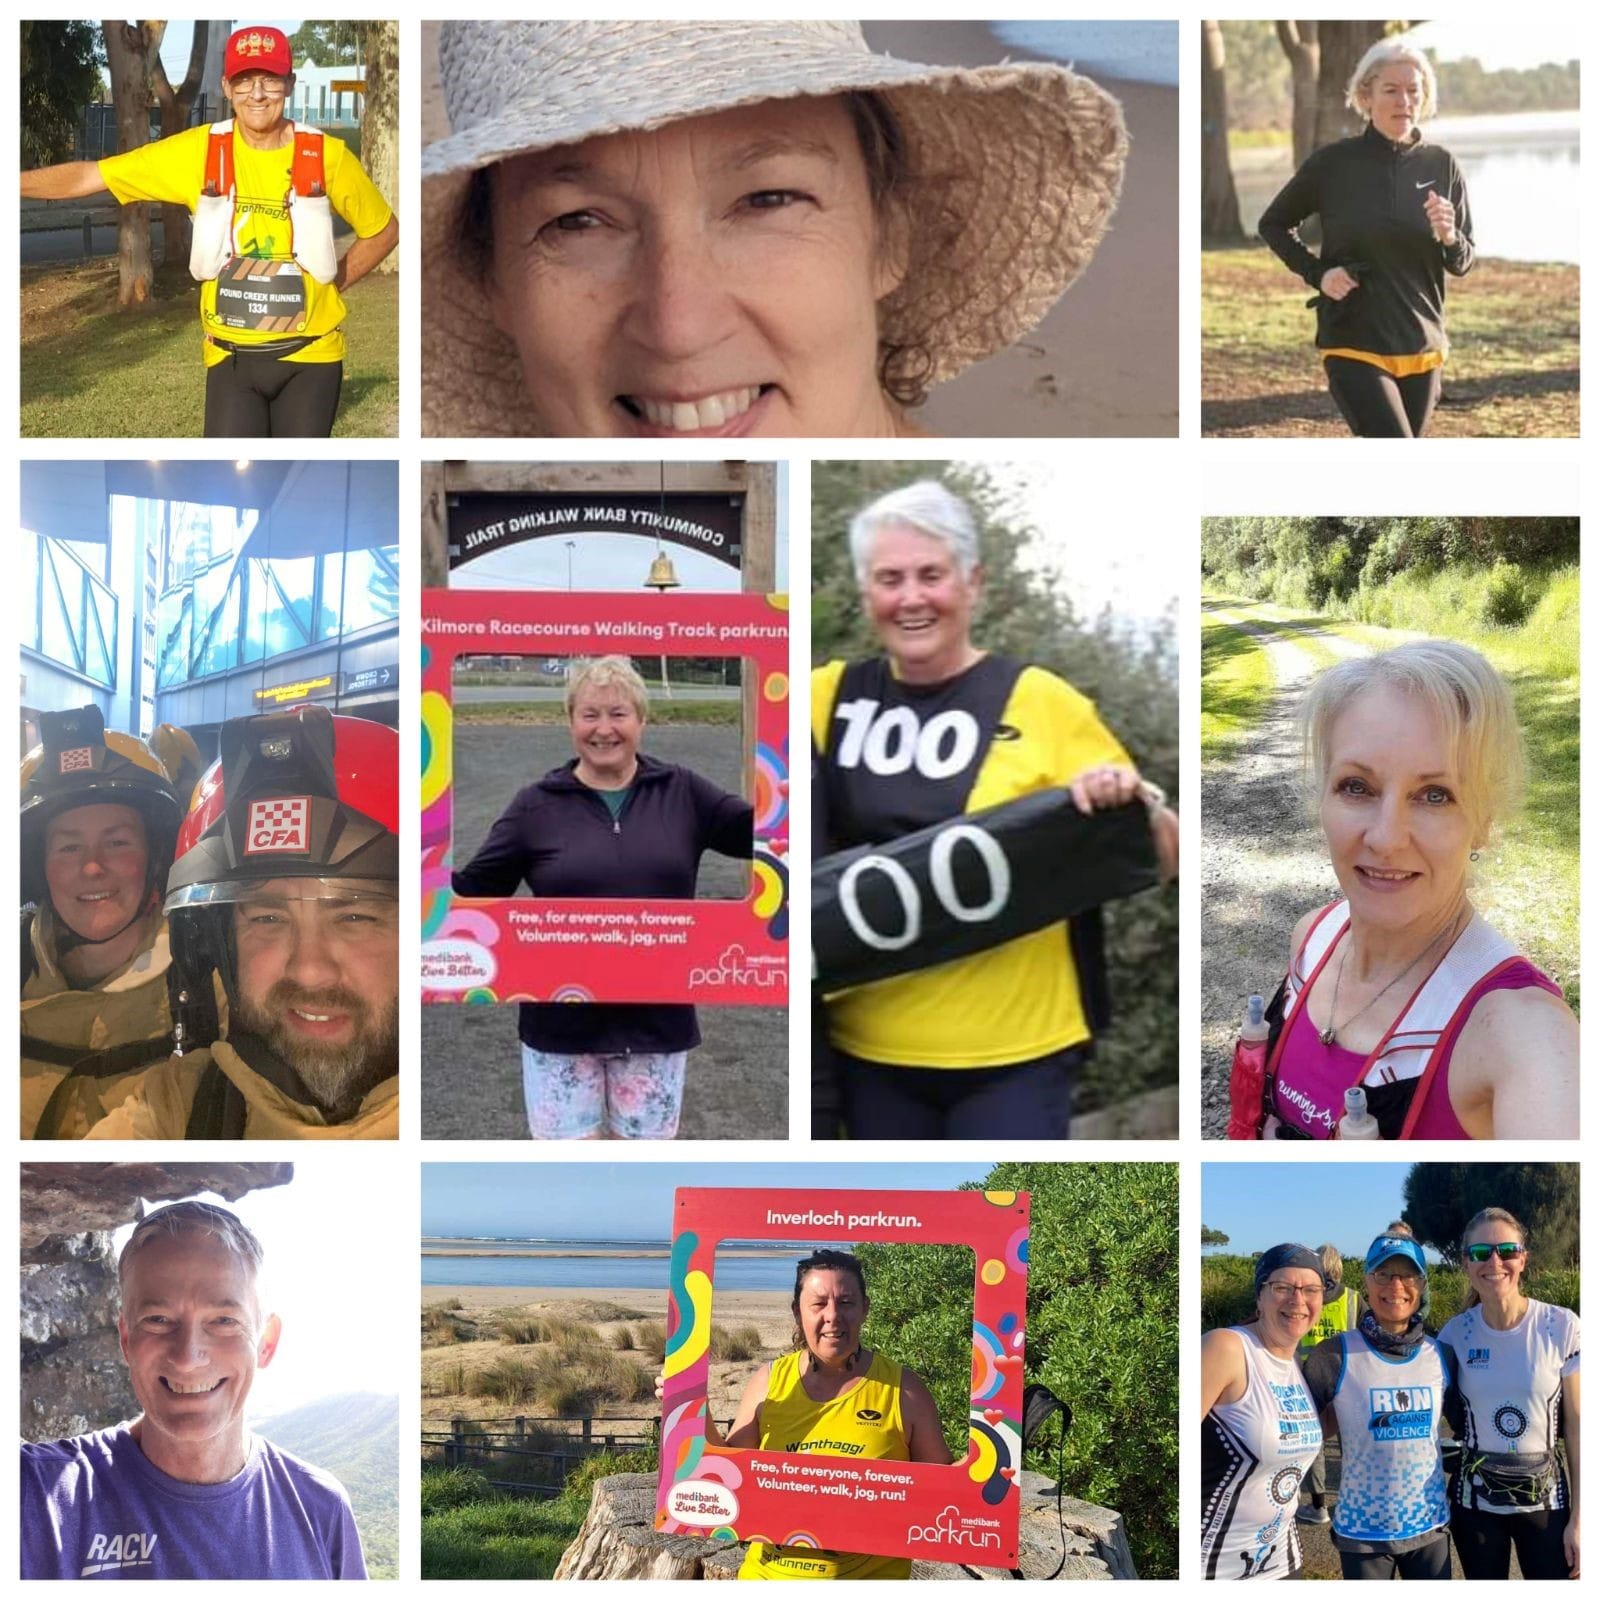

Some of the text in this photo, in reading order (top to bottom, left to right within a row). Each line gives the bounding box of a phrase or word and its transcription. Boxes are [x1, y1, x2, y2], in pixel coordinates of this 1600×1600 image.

[219, 288, 302, 303] POUND CREEK RUNNER
[248, 303, 268, 314] 1334
[421, 619, 486, 635] Kilmore
[490, 620, 591, 636] Racecourse
[595, 621, 664, 641] Walking
[668, 623, 716, 637] Track
[834, 698, 980, 780] 100
[63, 760, 90, 770] CFA
[253, 830, 301, 848] CFA
[812, 824, 1012, 978] 00
[508, 910, 696, 928] Free, for everyone, forever.
[516, 929, 688, 947] Volunteer, walk, jog, run!
[688, 944, 788, 990] parkrun
[766, 1209, 923, 1230] Inverloch parkrun.
[1373, 1389, 1431, 1412] RUN
[1391, 1413, 1431, 1424] AGAINST
[1375, 1425, 1430, 1439] VIOLENCE
[785, 1439, 866, 1455] Wonthaggi
[750, 1460, 914, 1485] Free, for everyone, forever.
[676, 1491, 720, 1503] medibank
[756, 1477, 906, 1502] Volunteer, walk, jog, run!
[674, 1501, 731, 1516] Live Better
[906, 1505, 1001, 1552] parkrun
[961, 1517, 1001, 1528] medibank
[86, 1533, 158, 1561] RACV
